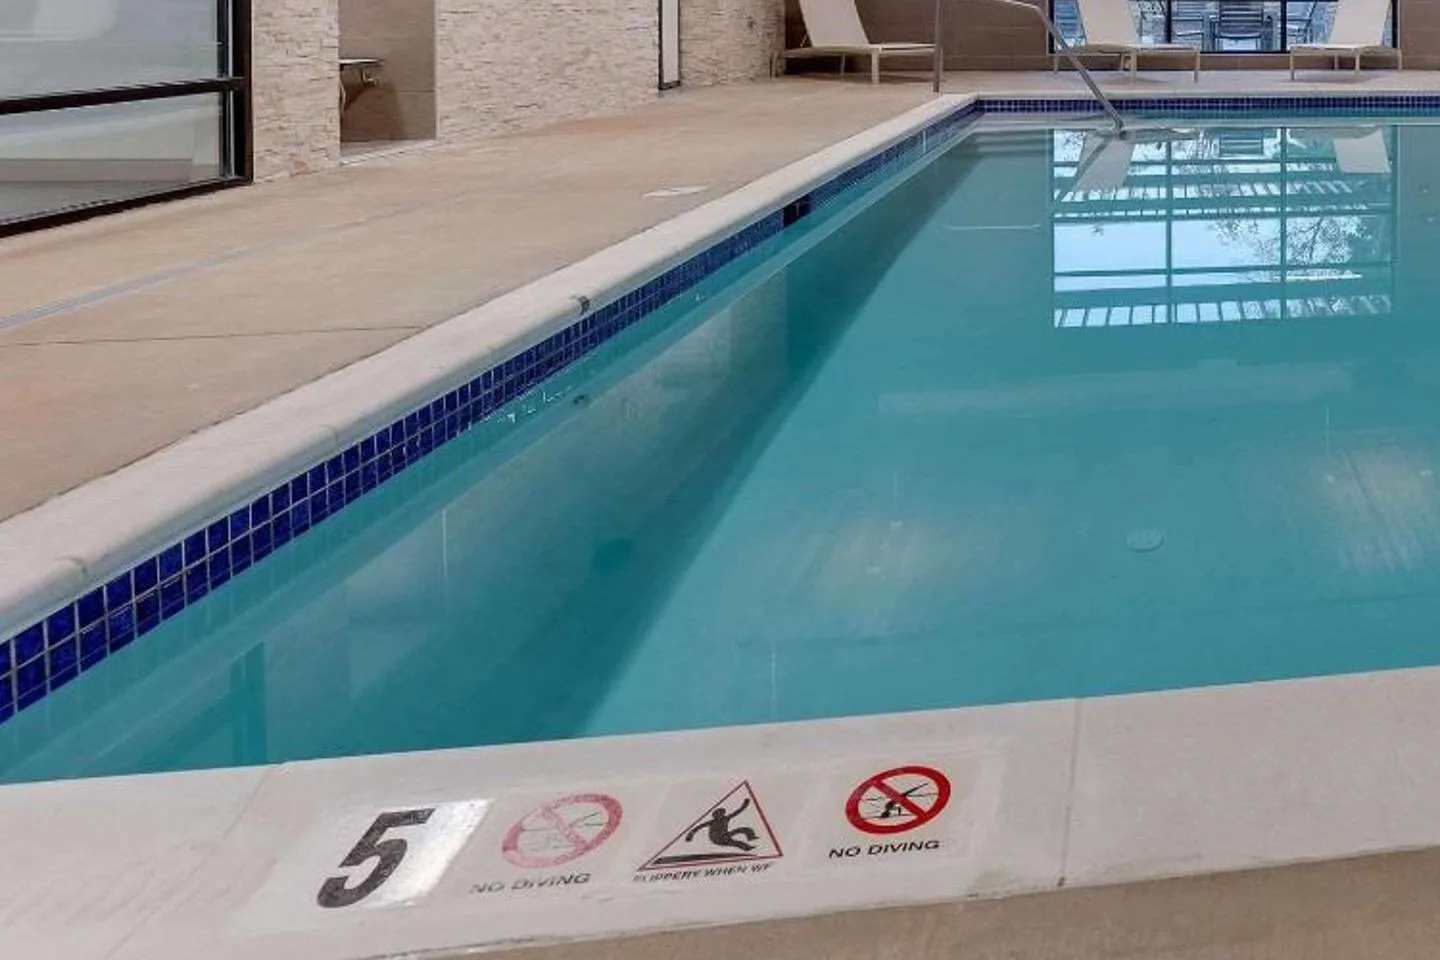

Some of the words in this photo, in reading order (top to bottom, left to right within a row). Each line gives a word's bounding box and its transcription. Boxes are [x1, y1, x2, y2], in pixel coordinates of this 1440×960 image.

[317, 808, 436, 908] 5
[828, 846, 861, 858] NO
[867, 840, 940, 855] DIVING
[703, 865, 747, 878] WHEN
[469, 882, 504, 894] NO
[511, 873, 592, 890] DIVING
